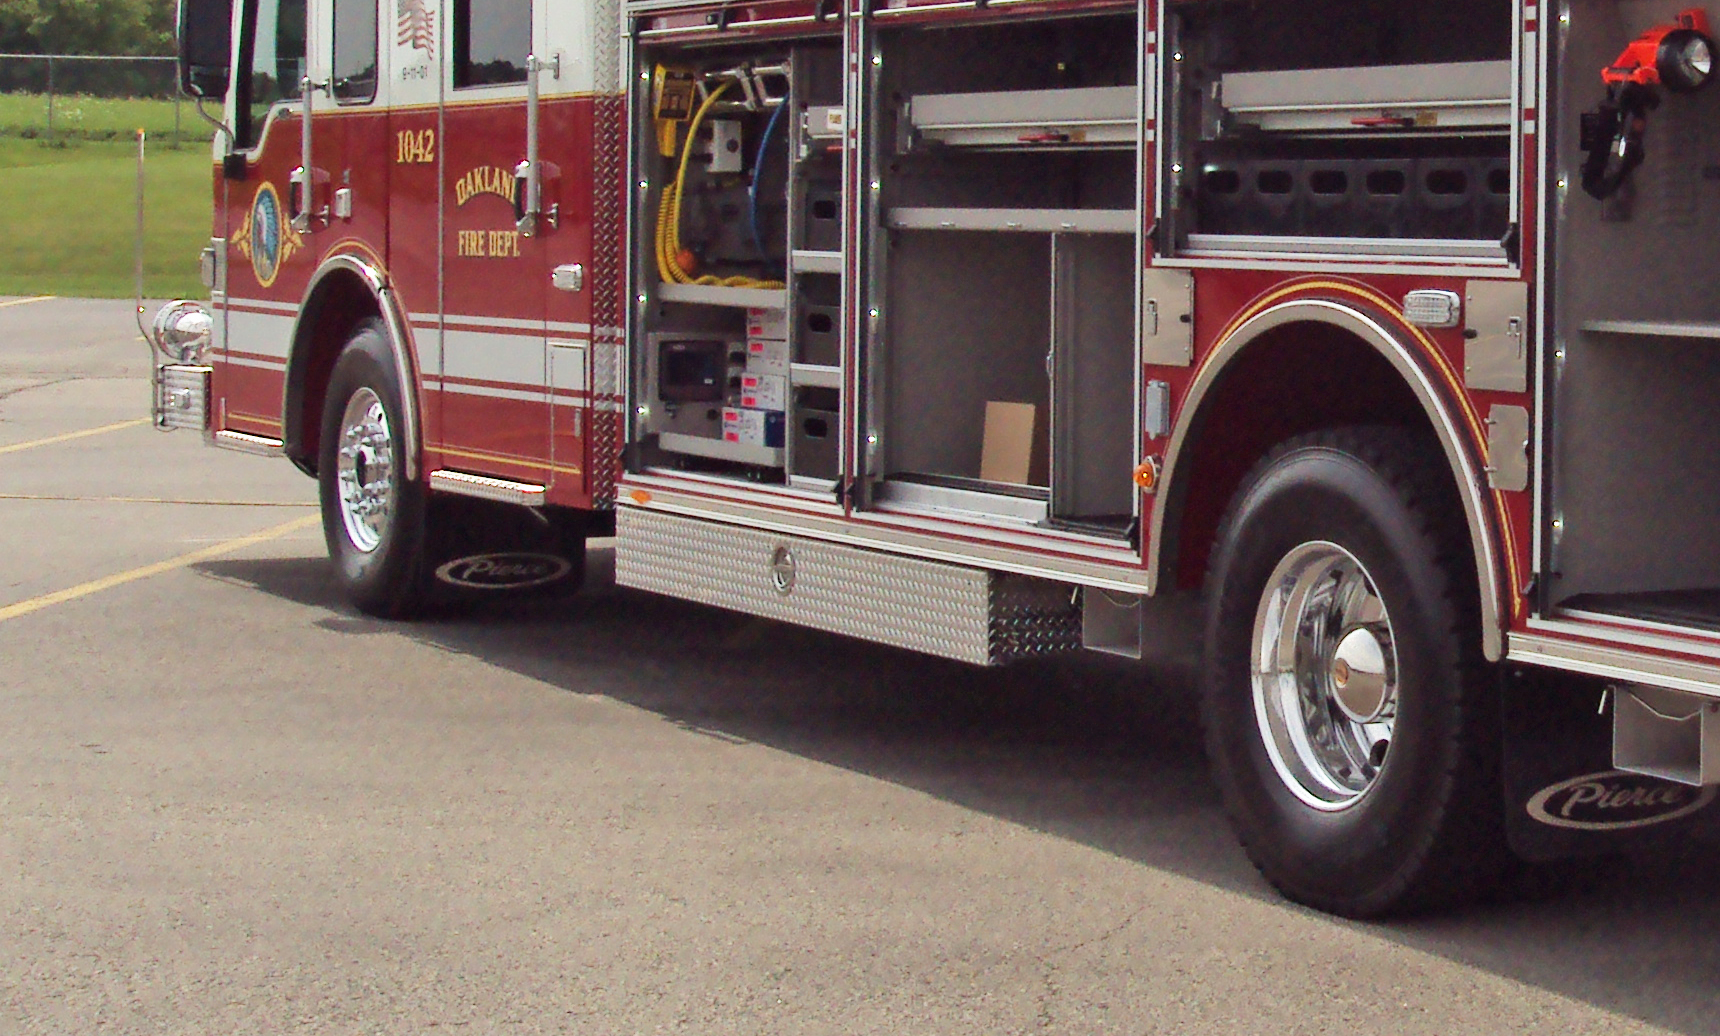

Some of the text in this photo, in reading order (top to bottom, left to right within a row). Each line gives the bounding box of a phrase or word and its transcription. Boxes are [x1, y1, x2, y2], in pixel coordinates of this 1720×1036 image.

[397, 129, 435, 163] 1042
[458, 230, 520, 257] FIRE DEPT.
[1561, 782, 1682, 817] Pierce
